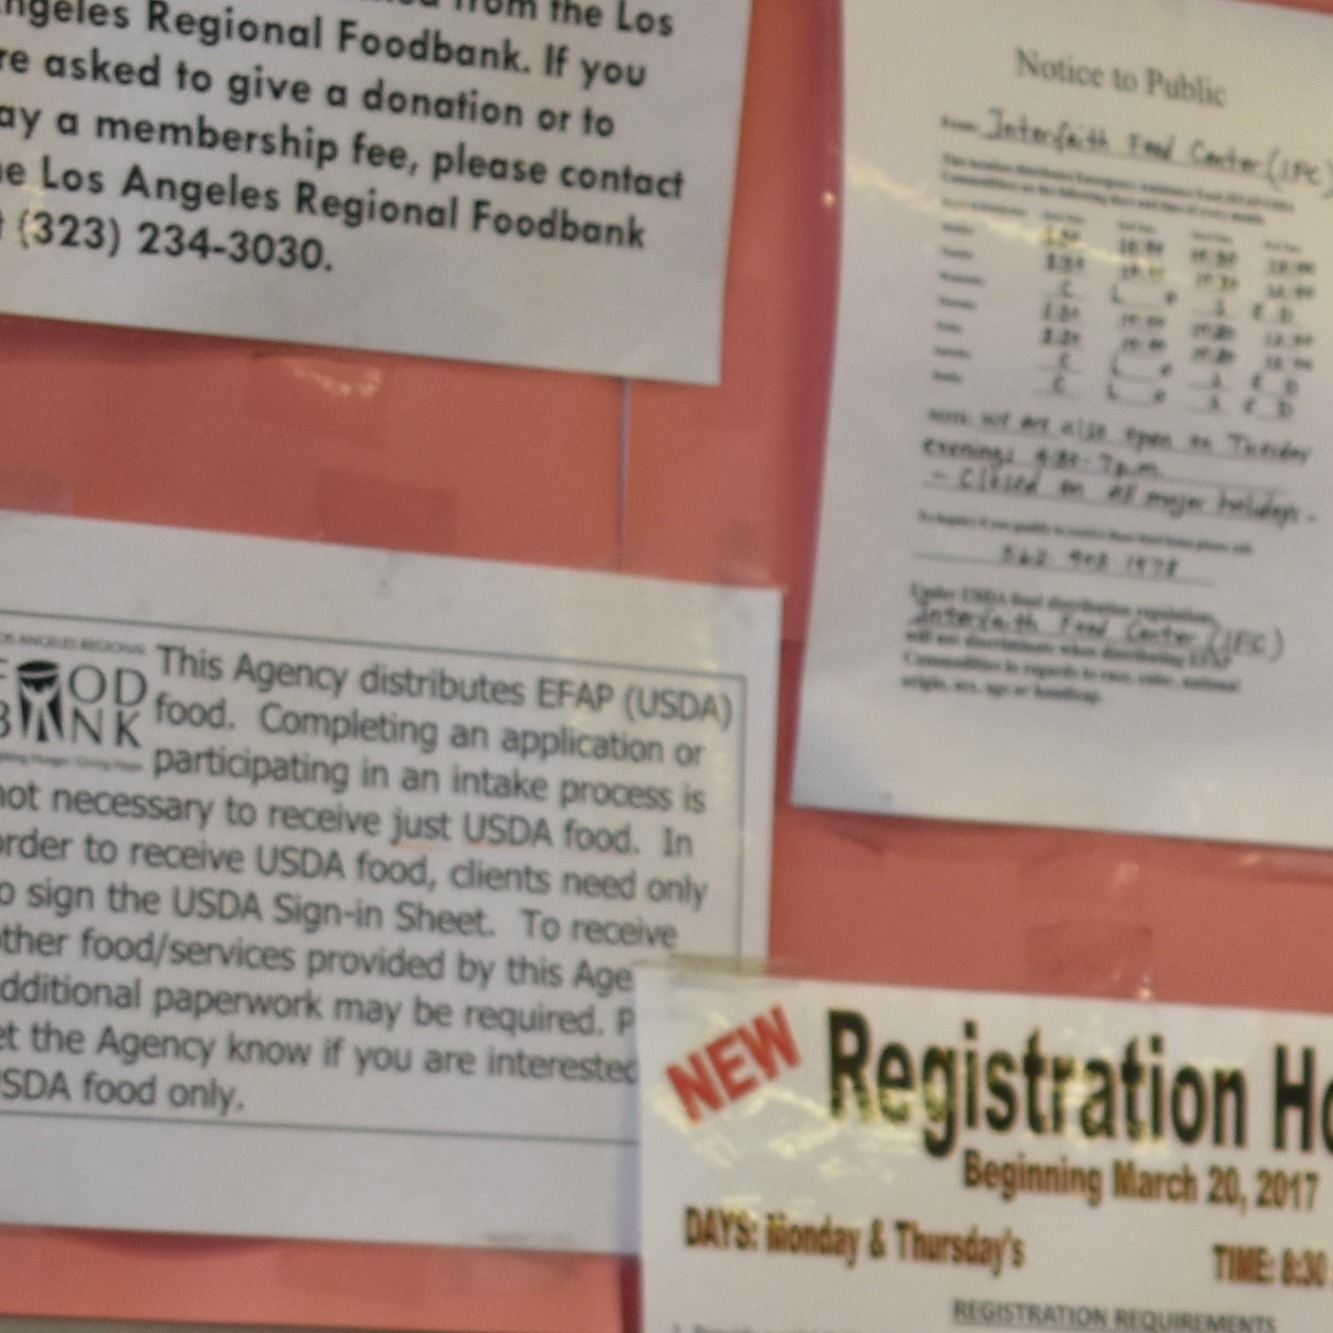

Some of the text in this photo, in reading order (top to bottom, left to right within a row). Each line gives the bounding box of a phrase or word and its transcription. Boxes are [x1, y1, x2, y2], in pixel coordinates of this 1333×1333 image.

[0, 0, 646, 90] ngeles Regional Foodbank. If you
[617, 0, 674, 37] Los
[0, 48, 615, 137] re asked to give a donation or to
[1016, 48, 1227, 108] Notice to Public
[0, 105, 684, 198] ay a membership fee, please contact
[42, 155, 104, 194] Los
[121, 164, 279, 211] Angeles
[295, 180, 458, 228] Regional
[470, 198, 646, 249] Foodbank
[19, 209, 120, 258] (323)
[138, 220, 333, 272] 234-3030.
[156, 643, 733, 731] This Agency distributes EFAP (USDA)
[156, 691, 705, 767] food. Completing an application or
[154, 745, 349, 793] participating
[361, 757, 389, 788] in
[402, 767, 440, 793] an
[452, 765, 548, 801] intake
[559, 778, 673, 808] process
[683, 784, 706, 814] is
[53, 785, 213, 829] necessary
[226, 797, 257, 827] to
[268, 803, 381, 836] receive
[391, 806, 452, 845] just
[463, 812, 552, 846] USDA
[564, 819, 639, 855] food.
[662, 826, 693, 858] In
[86, 832, 118, 865] to
[129, 838, 244, 873] receive
[256, 845, 345, 880] USDA
[356, 852, 435, 892] food,
[451, 859, 550, 894] clients
[562, 870, 636, 900] need
[647, 875, 707, 911] only
[27, 879, 678, 948] sign the USDA Sign-in Sheet. To receive
[0, 924, 634, 998] ther food/services provided by this Age
[0, 972, 141, 1009] dditional
[154, 986, 322, 1020] paperwork
[334, 997, 401, 1032] may
[413, 994, 453, 1028] be
[464, 1004, 604, 1038] required.
[31, 1022, 86, 1054] the
[97, 1026, 216, 1068] Agency
[227, 1031, 312, 1067] know
[322, 1036, 346, 1068] if
[355, 1047, 412, 1077] you
[424, 1050, 477, 1076] are
[664, 1004, 800, 1125] NEW
[827, 1008, 1246, 1158] Registration
[0, 1069, 245, 1117] SDA food only.
[964, 1148, 1319, 1217] Beginning March 20, 2017
[764, 1208, 861, 1269] Monday
[869, 1217, 886, 1259] &
[896, 1218, 1026, 1277] Thursday's
[1212, 1243, 1275, 1284] TIME:
[1281, 1249, 1327, 1288] 8:30
[953, 1299, 1107, 1332] REGISTRATION
